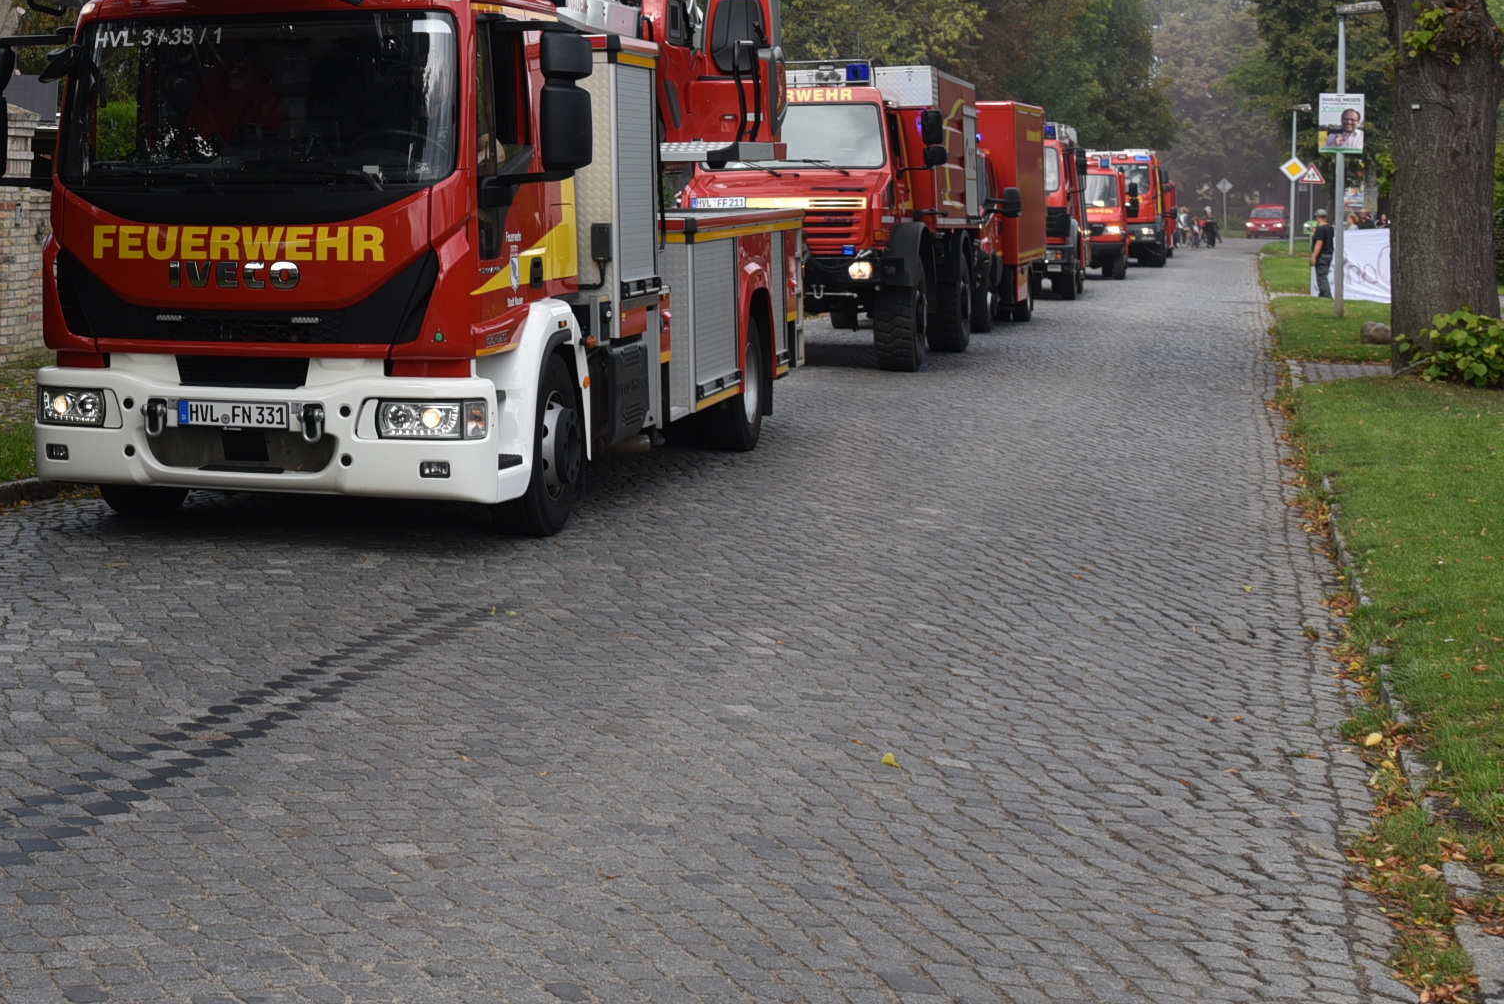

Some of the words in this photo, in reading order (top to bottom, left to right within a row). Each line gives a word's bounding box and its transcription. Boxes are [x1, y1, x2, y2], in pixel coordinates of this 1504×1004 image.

[94, 29, 135, 49] HVL
[786, 88, 853, 103] RWEHR
[697, 199, 712, 208] HVL
[717, 199, 728, 207] FF
[729, 198, 744, 207] 211
[93, 225, 386, 263] FEUERWEHR
[169, 260, 300, 290] IVECO
[189, 403, 220, 423] HVL
[231, 405, 252, 424] FN
[256, 406, 285, 426] 331
